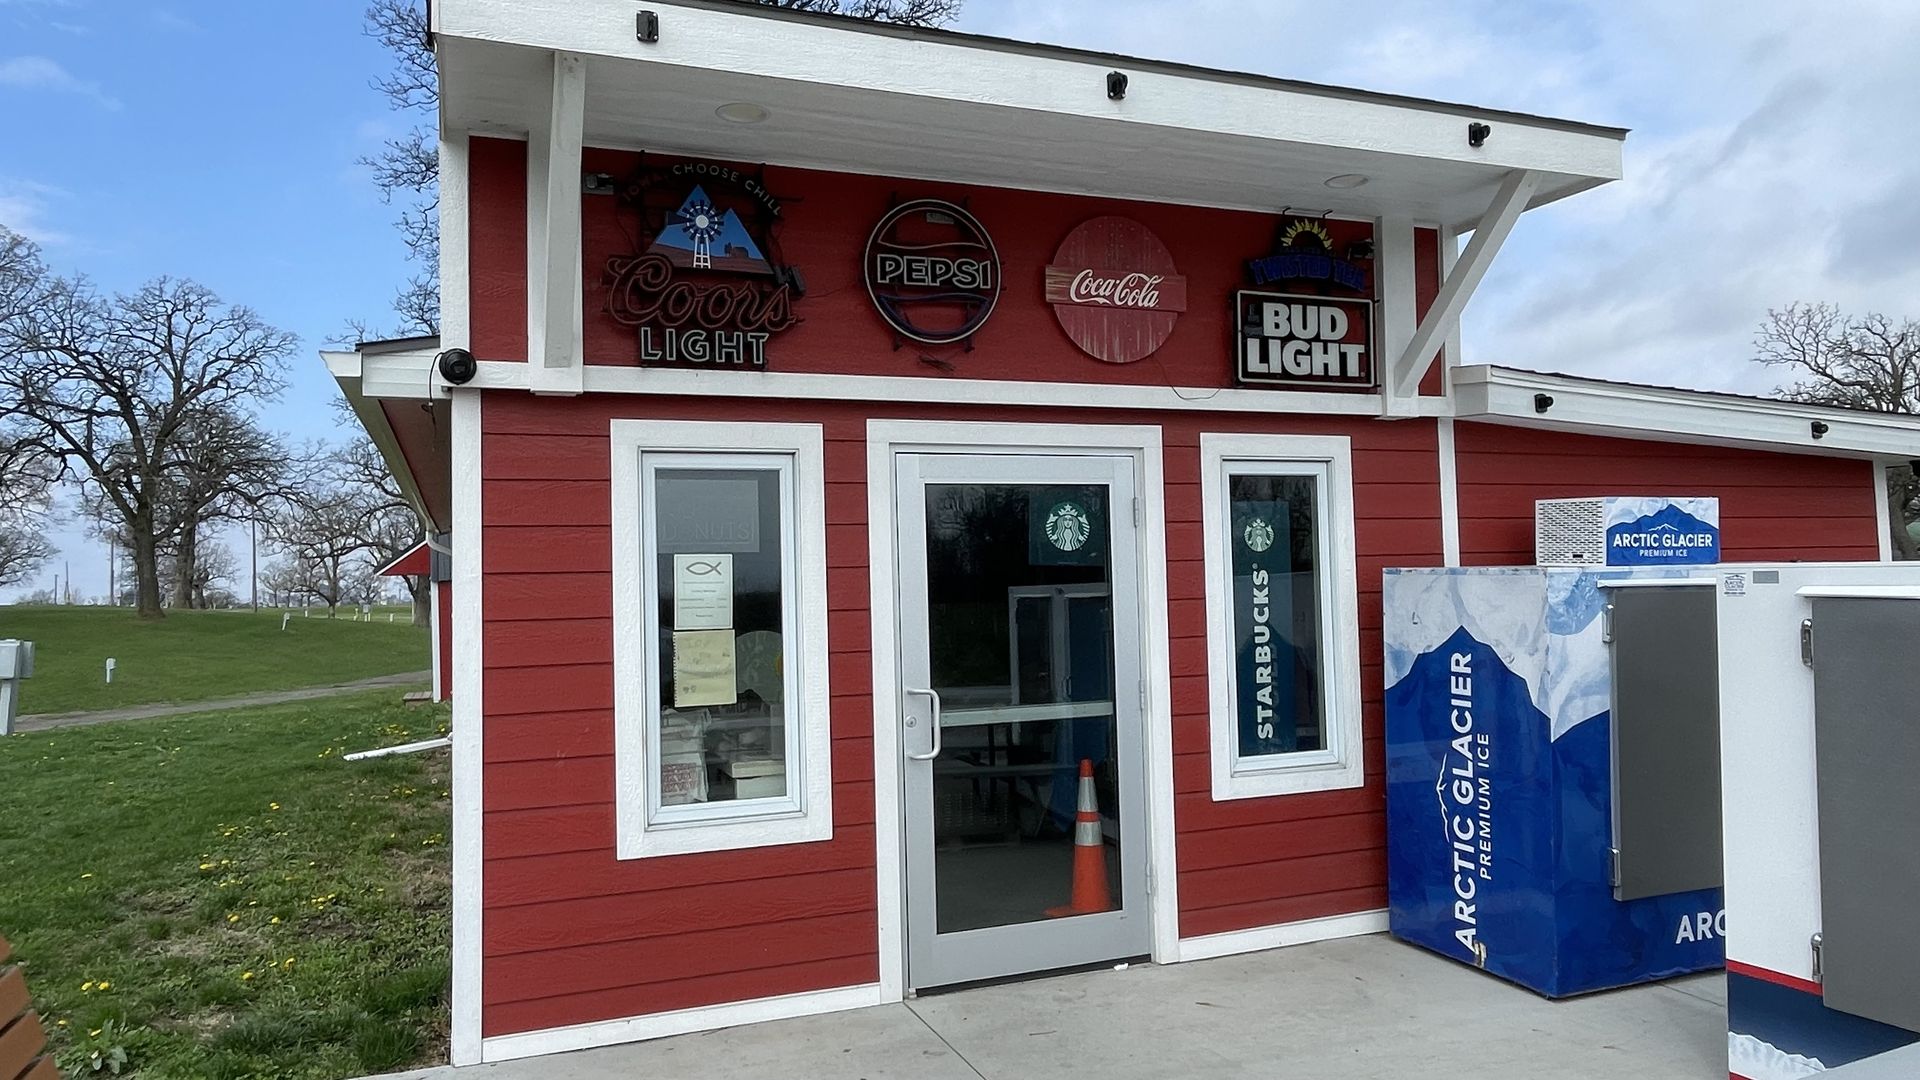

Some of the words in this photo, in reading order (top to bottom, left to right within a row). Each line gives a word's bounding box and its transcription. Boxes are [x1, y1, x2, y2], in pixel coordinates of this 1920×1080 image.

[672, 163, 739, 183] CHOOSE
[744, 179, 782, 216] CHILL
[877, 254, 992, 289] PEPSI
[1070, 269, 1165, 308] Coca-Cola
[607, 255, 798, 332] Coors
[1263, 302, 1349, 341] BUD
[641, 326, 770, 365] LIGHT
[1247, 337, 1365, 378] LIGHT
[1613, 533, 1660, 548] ARCTIC
[1662, 533, 1713, 548] GLACIER
[1639, 549, 1674, 557] PREMIUM
[1675, 549, 1688, 557] ICE
[1252, 569, 1274, 739] STARBUCKS
[1450, 652, 1475, 805] GLACIER
[1477, 733, 1489, 768] ICE
[1478, 777, 1492, 881] PREMIUM
[1453, 815, 1477, 955] ARCTIC
